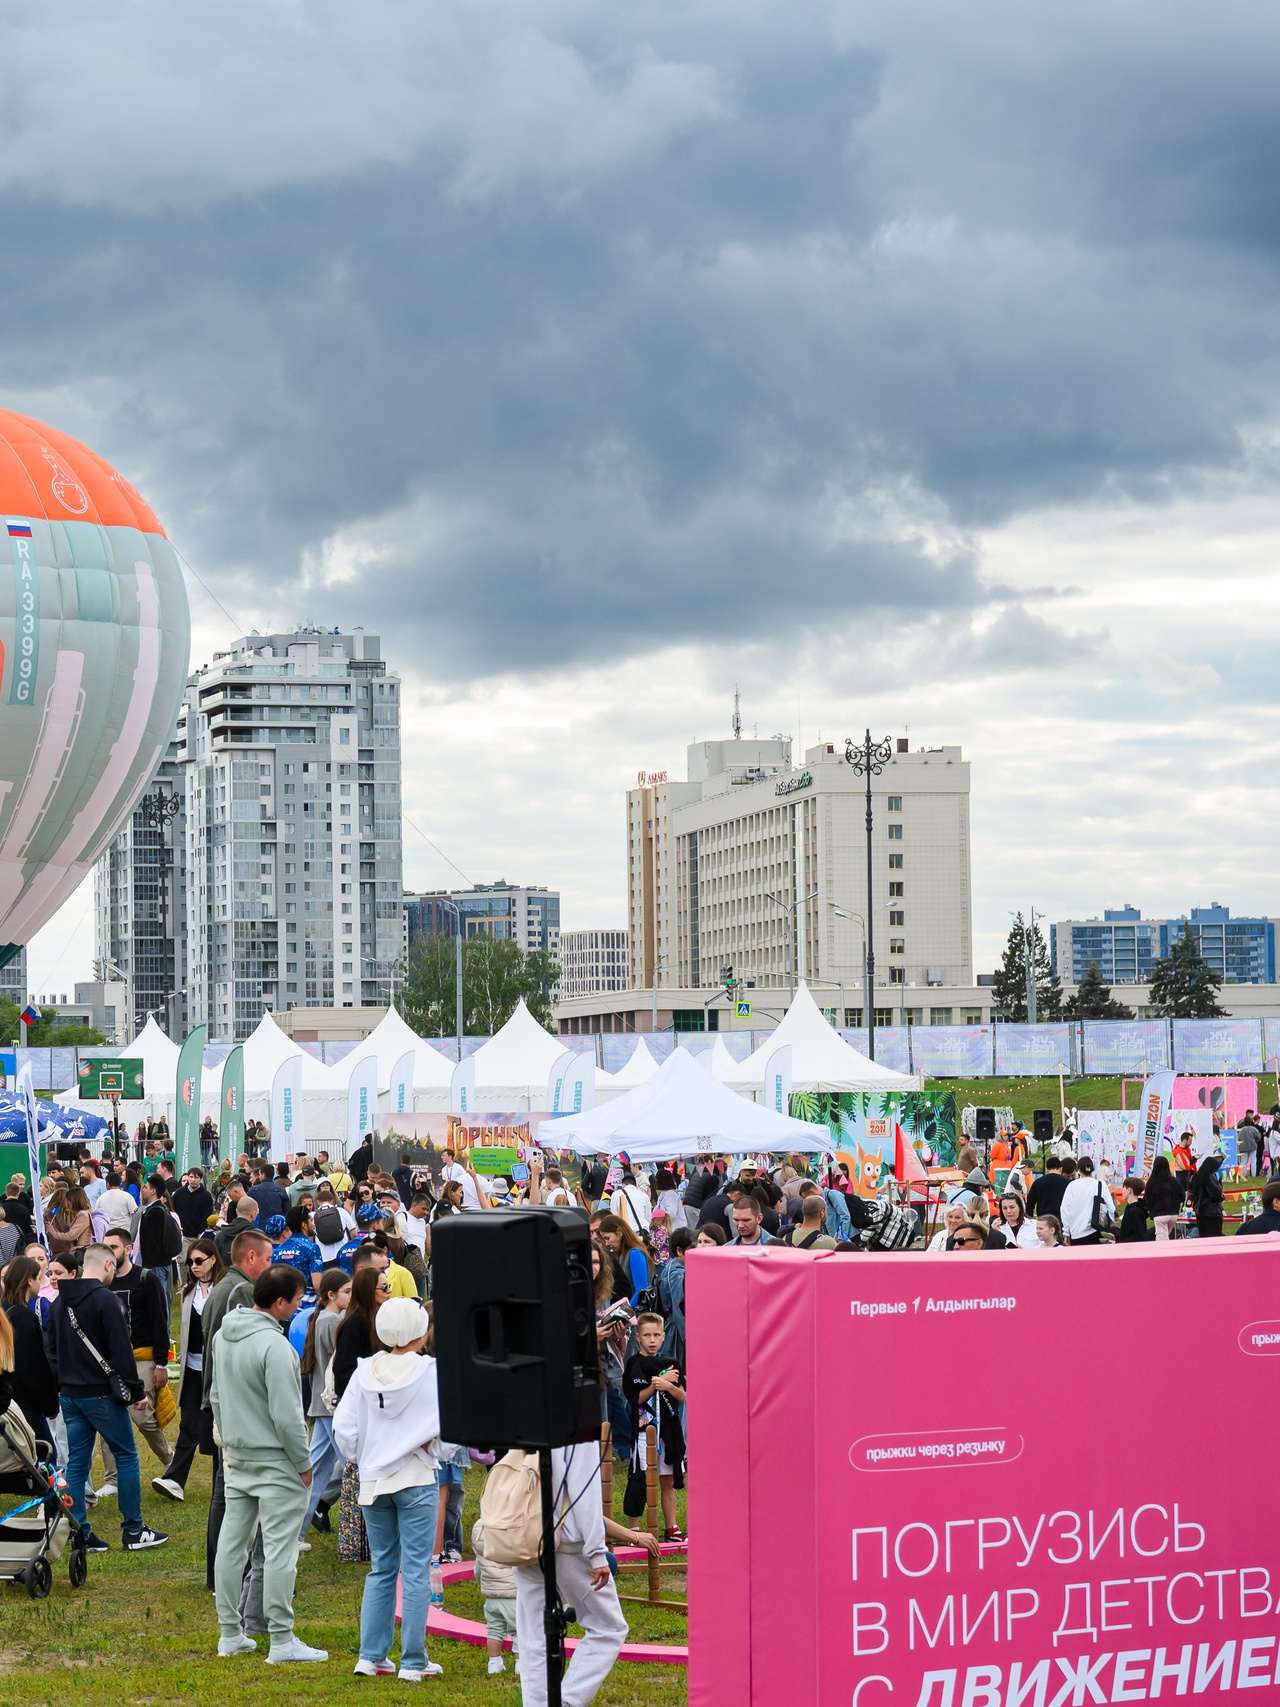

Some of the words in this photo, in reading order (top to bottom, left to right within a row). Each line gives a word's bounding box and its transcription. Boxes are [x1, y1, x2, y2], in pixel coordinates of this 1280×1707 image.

[16, 539, 35, 701] RA-3399G
[870, 1125, 887, 1134] ZON
[1143, 1094, 1161, 1170] АКТИВИZON
[850, 1300, 907, 1317] Первые
[925, 1297, 1017, 1312] Алдынгылар
[866, 1445, 916, 1462] прыжки
[918, 1443, 955, 1458] через
[956, 1440, 1006, 1457] резинку
[851, 1503, 1206, 1581] ПОГРУЗИСЬ
[852, 1602, 890, 1656] В
[908, 1588, 1040, 1650] МИР
[913, 1636, 1280, 1707] ДВИЖЕНИЕ
